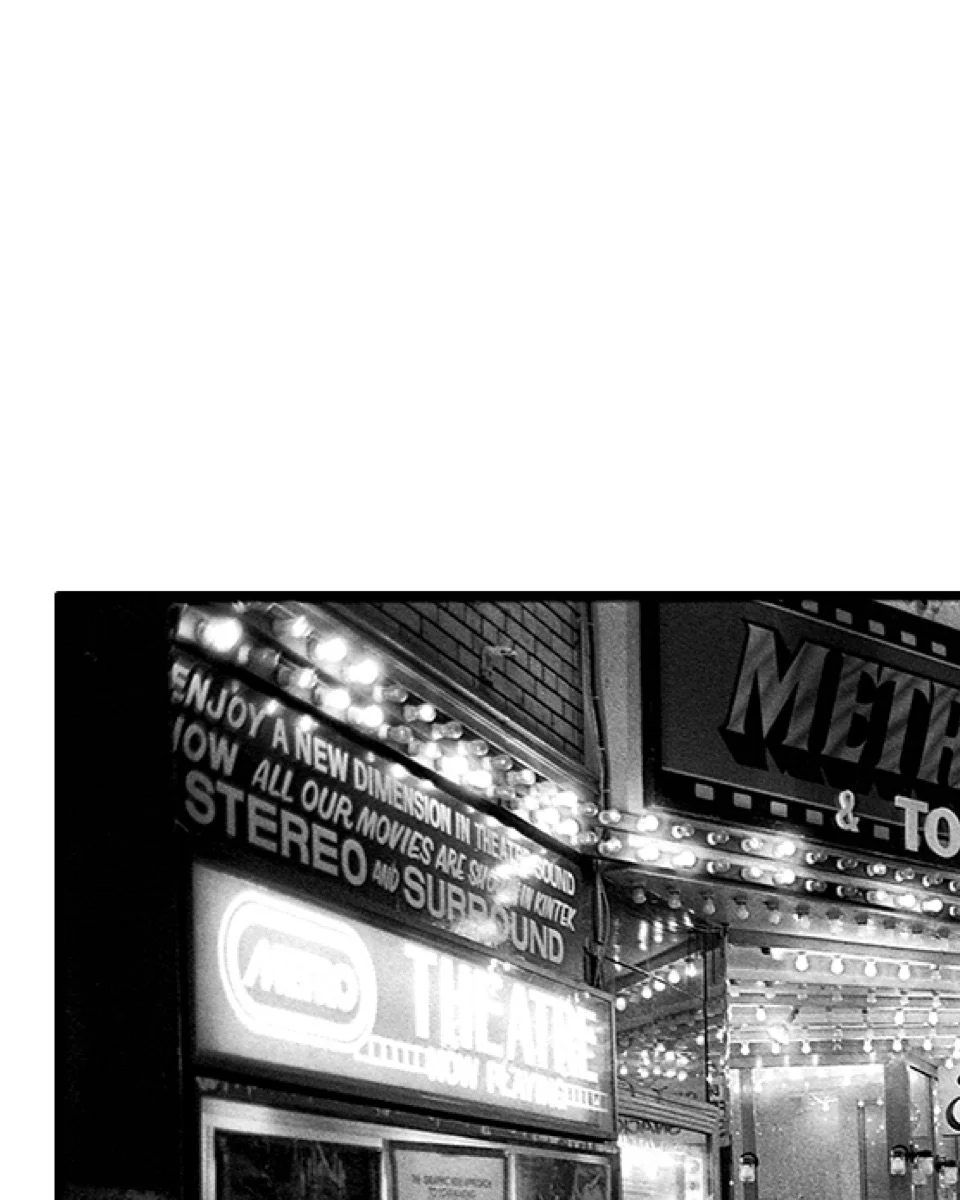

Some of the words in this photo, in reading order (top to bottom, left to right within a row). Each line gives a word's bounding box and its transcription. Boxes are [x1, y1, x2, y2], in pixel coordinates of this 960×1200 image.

[171, 661, 265, 738] ENJOY
[272, 717, 290, 756] A
[295, 724, 350, 783] NEW
[352, 756, 452, 837] DIMENSION
[454, 812, 471, 846] IN
[474, 820, 529, 864] THEAT
[533, 857, 576, 897] SOUND
[250, 758, 295, 803] ALL
[300, 780, 354, 831] OUR
[355, 805, 435, 867] MOVIES
[435, 844, 468, 880] ARE
[467, 859, 512, 897] SHO
[834, 789, 862, 833] &
[185, 769, 368, 887] STEREO
[372, 858, 401, 893] AND
[402, 864, 565, 965] SURROUND
[241, 937, 361, 1013] METRO
[404, 942, 600, 1085] THEATRE
